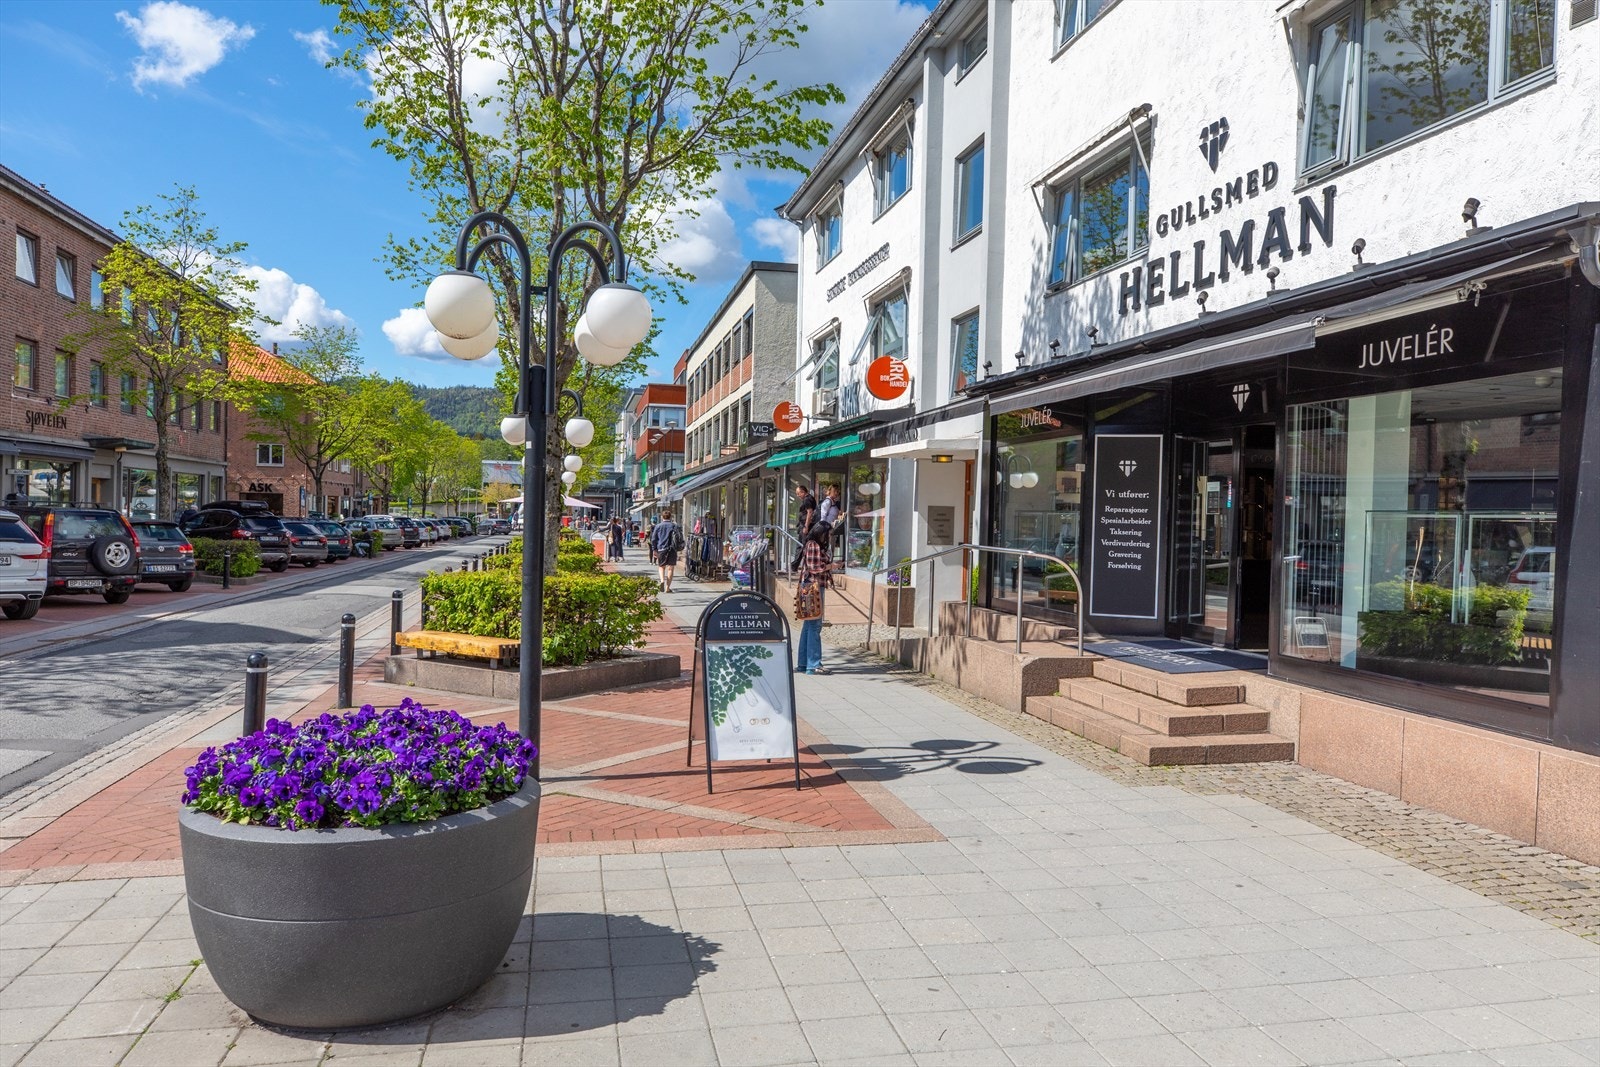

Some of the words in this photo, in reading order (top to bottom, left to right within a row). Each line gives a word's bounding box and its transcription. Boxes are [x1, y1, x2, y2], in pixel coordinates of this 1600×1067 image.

[1156, 161, 1279, 238] GULLSMED
[1118, 185, 1337, 315] HELLMAN
[1358, 324, 1454, 369] JUVELÉR
[25, 410, 67, 433] SJØVEIEN
[1020, 405, 1052, 429] JUVELÉR
[751, 425, 769, 433] VIC
[248, 482, 273, 493] ASK
[1105, 489, 1115, 498] Vi
[1118, 490, 1150, 499] utfører:
[1104, 505, 1149, 515] Reparasjoner
[1100, 516, 1152, 526] Spesialarbeider
[1109, 528, 1142, 537] Taksering
[1100, 539, 1151, 548] Verdivurdering
[1108, 550, 1142, 559] Gravering
[1107, 562, 1142, 571] Forsølving
[719, 620, 771, 628] HELLMAN
